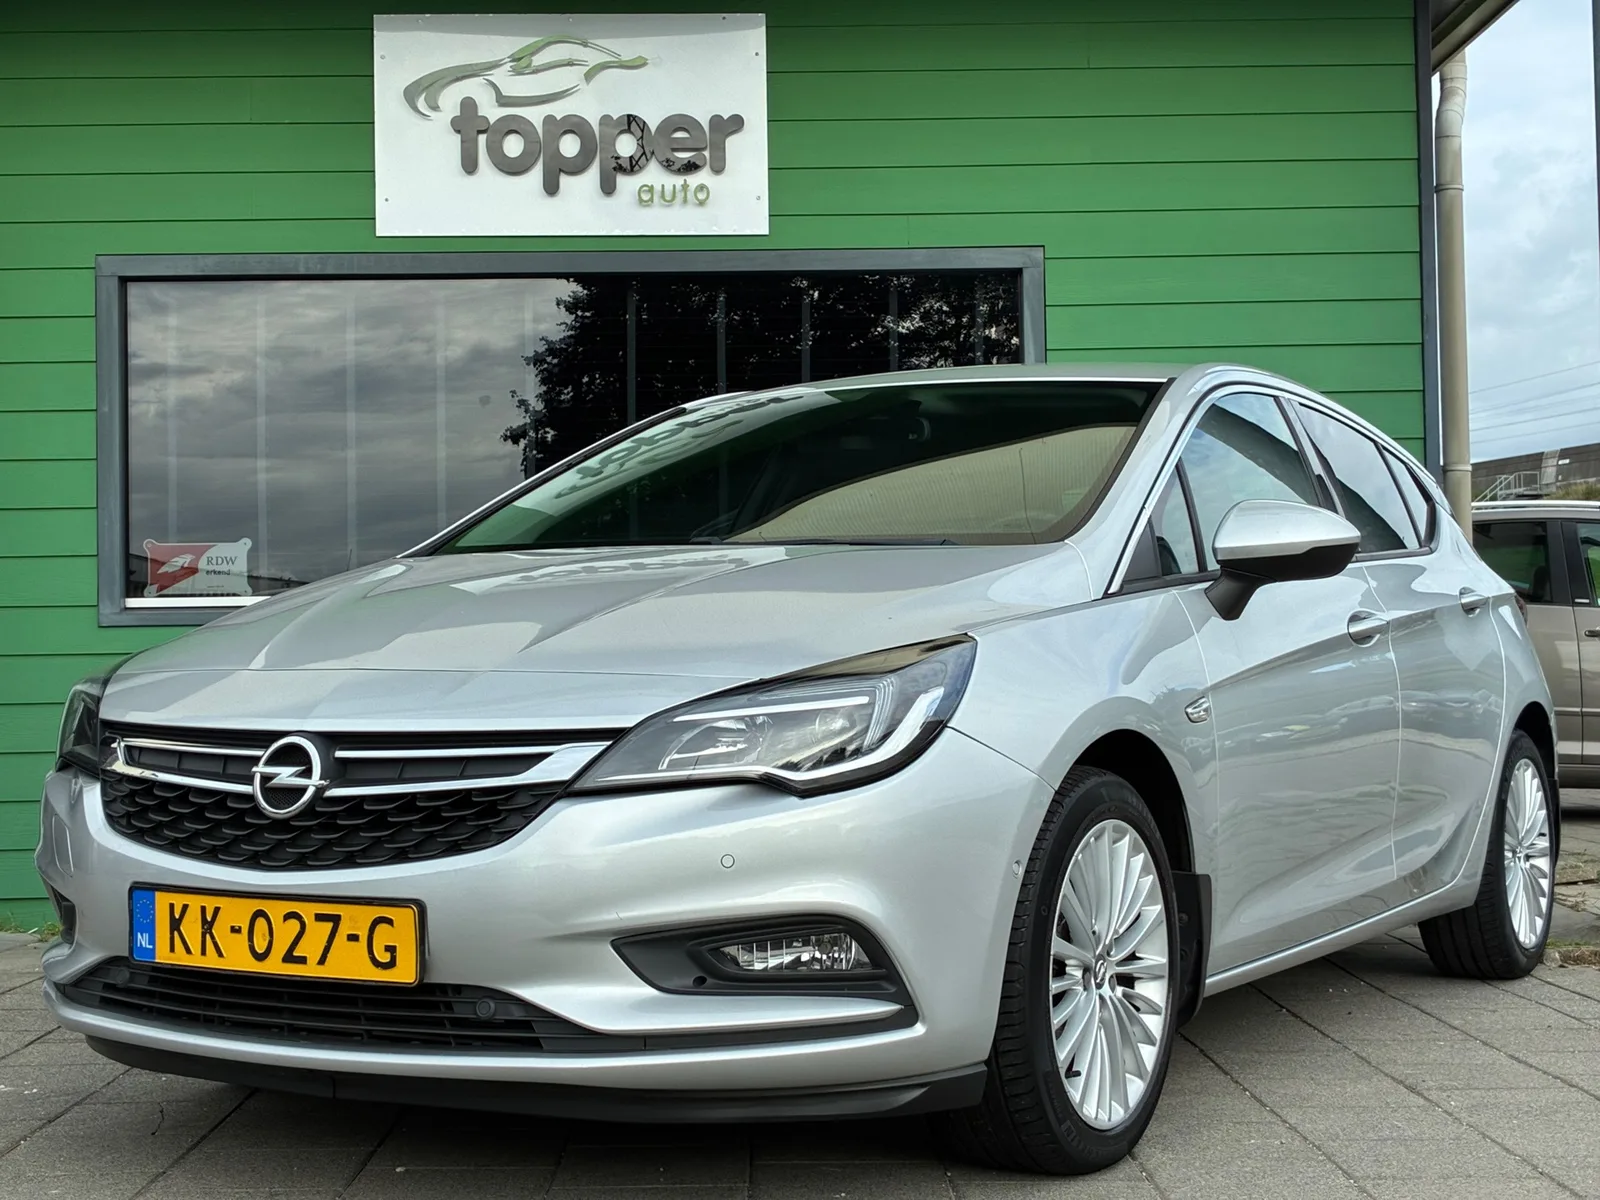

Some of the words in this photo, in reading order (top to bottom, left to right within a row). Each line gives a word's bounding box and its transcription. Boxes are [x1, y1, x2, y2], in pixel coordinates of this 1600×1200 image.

[450, 96, 745, 196] topper
[637, 178, 711, 207] auto
[205, 555, 238, 566] RDW
[136, 932, 153, 949] NL
[168, 901, 399, 970] KK-027-G
